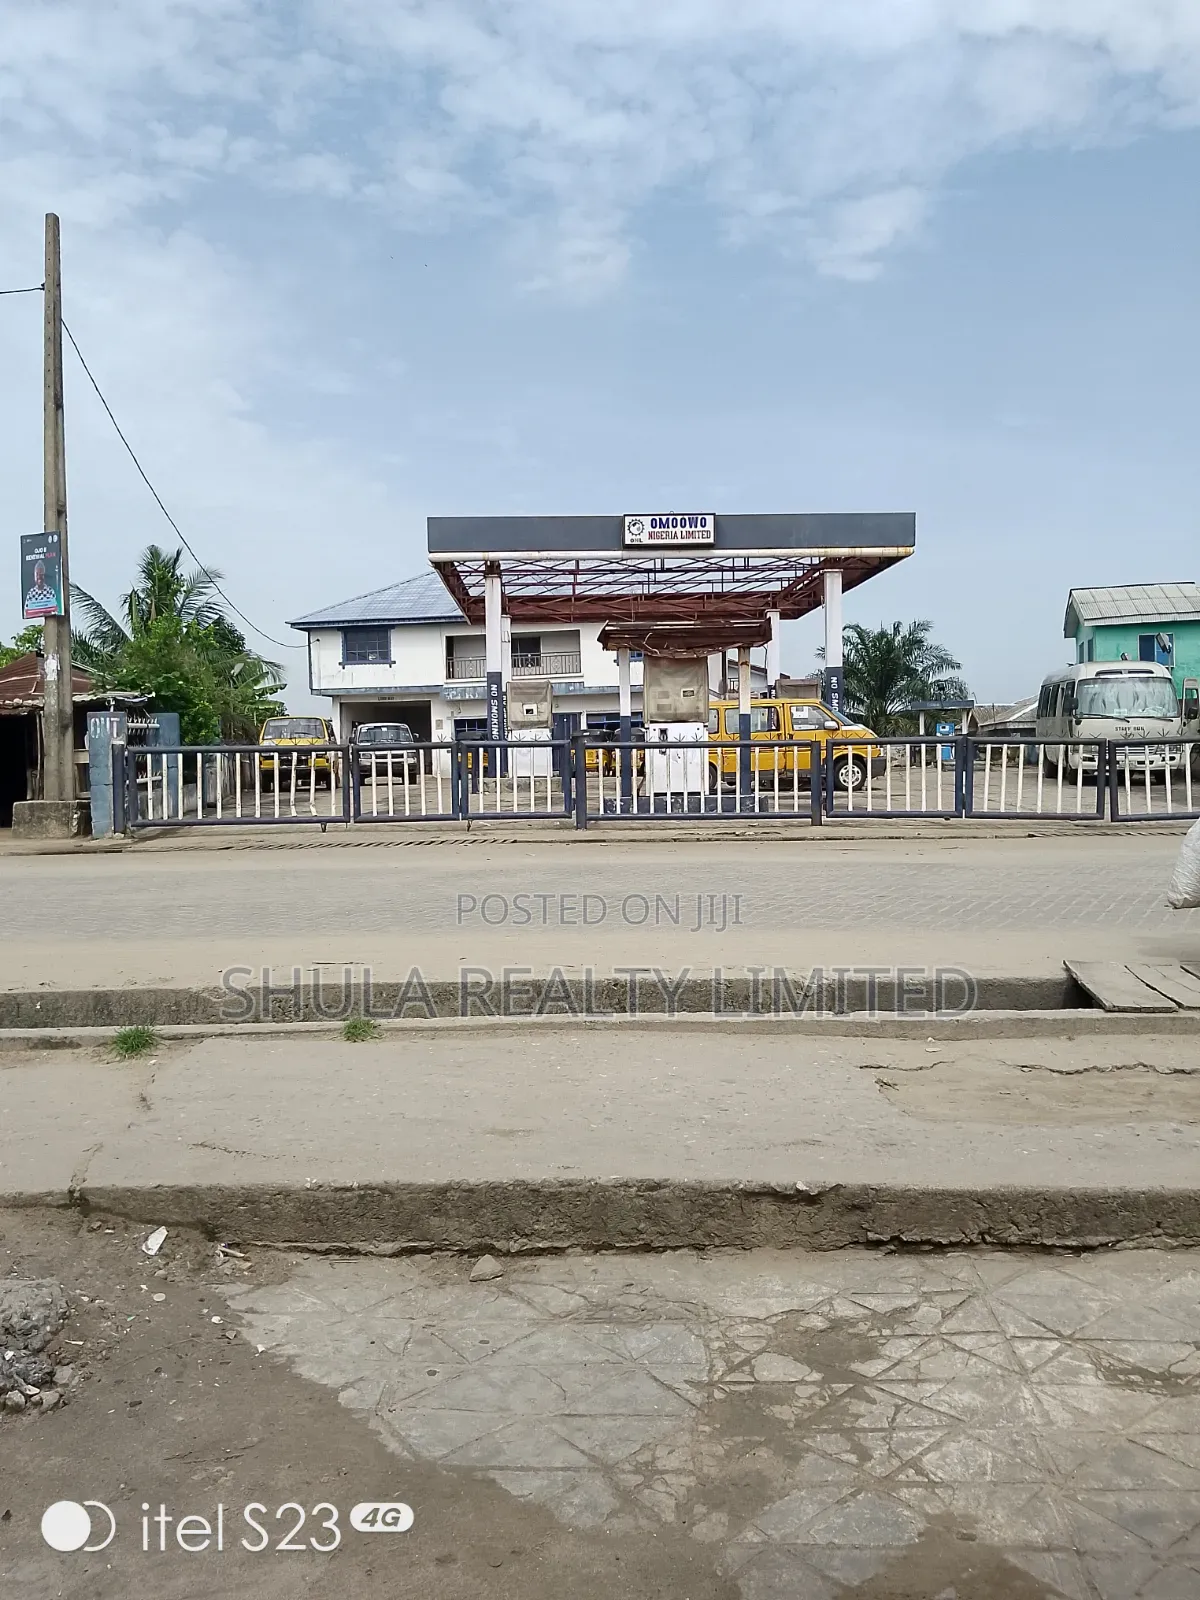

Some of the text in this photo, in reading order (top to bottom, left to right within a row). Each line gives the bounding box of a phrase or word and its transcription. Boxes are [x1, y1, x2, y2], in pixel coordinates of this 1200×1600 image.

[650, 516, 707, 529] OMOOWO
[648, 530, 711, 541] NIGERIA LIMITED
[830, 676, 838, 689] NO
[490, 684, 500, 740] NO SMOKING
